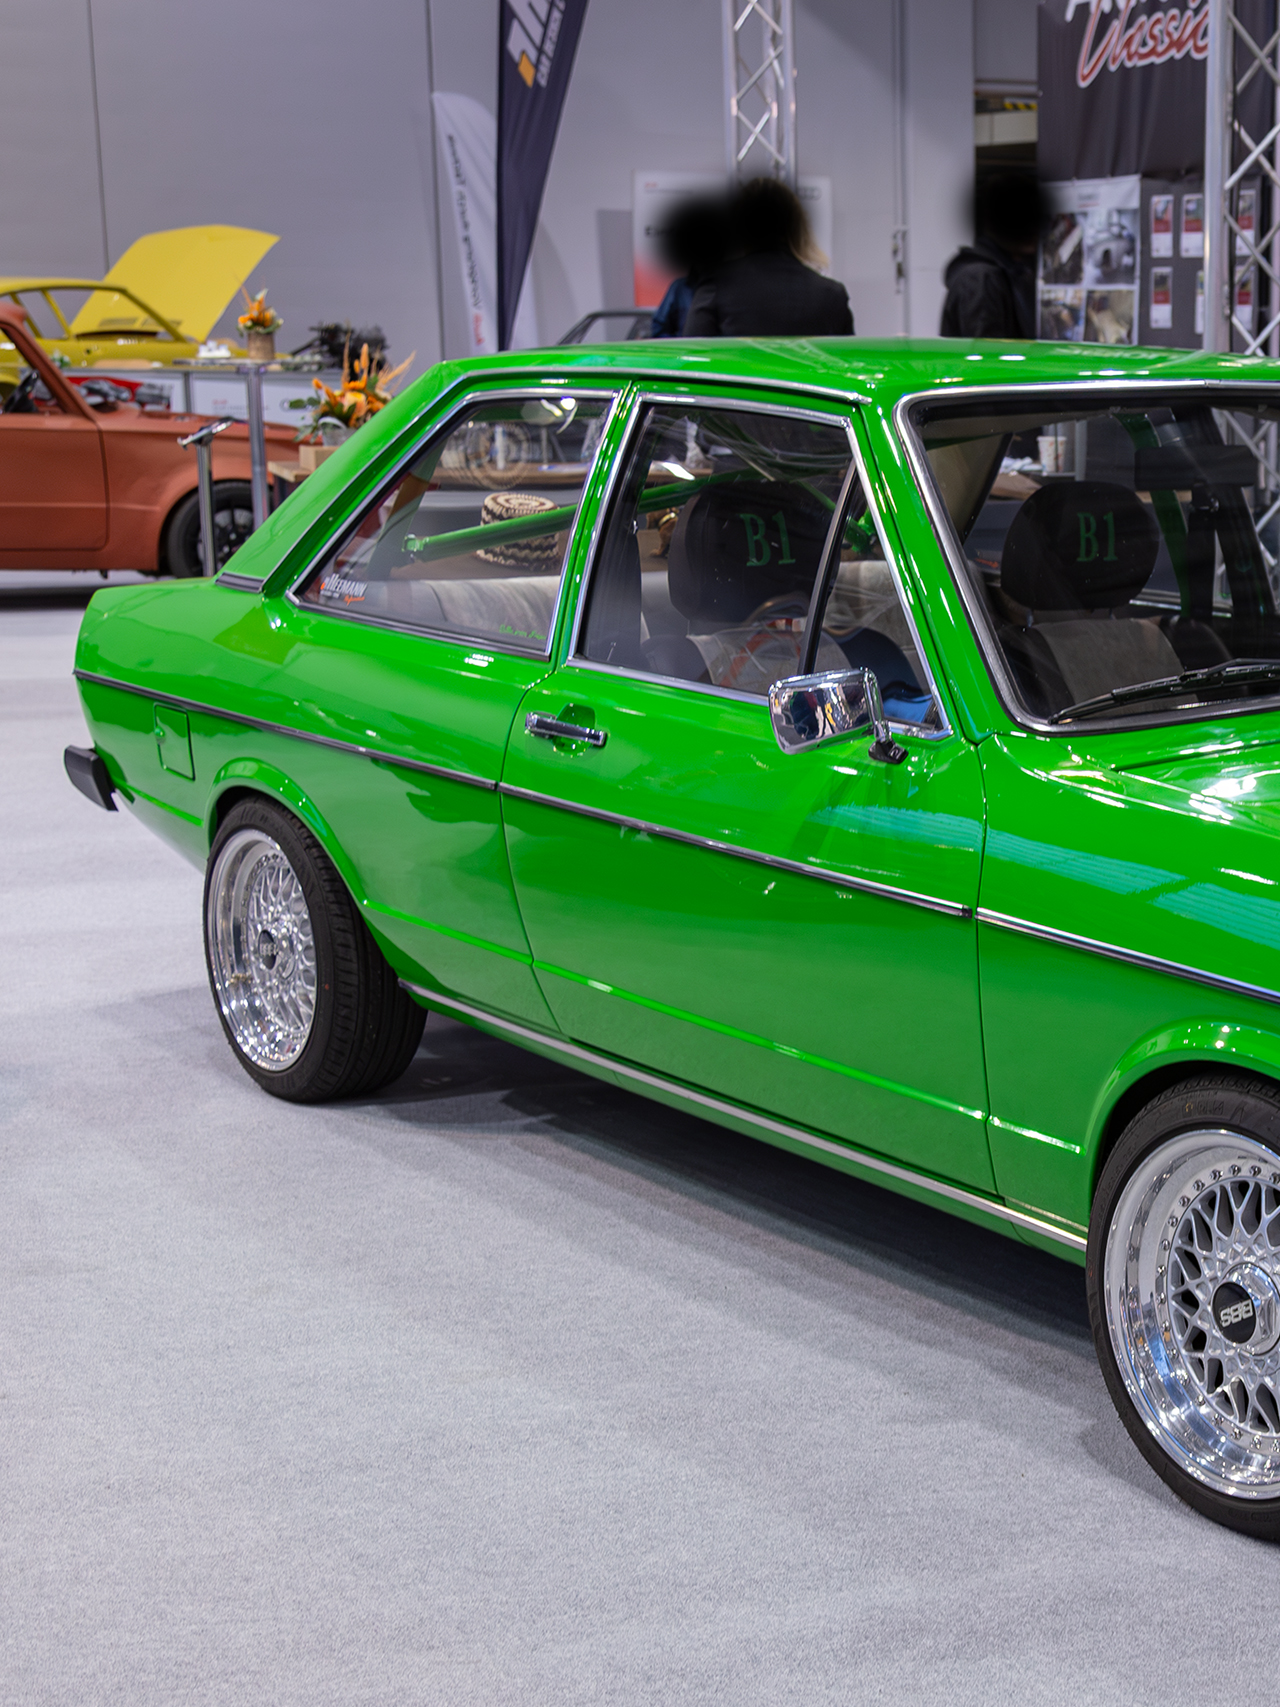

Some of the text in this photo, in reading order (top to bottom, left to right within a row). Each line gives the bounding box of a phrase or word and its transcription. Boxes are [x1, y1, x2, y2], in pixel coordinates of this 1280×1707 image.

[739, 511, 796, 567] B1
[1075, 511, 1118, 562] B1
[1220, 1299, 1253, 1328] BBS
